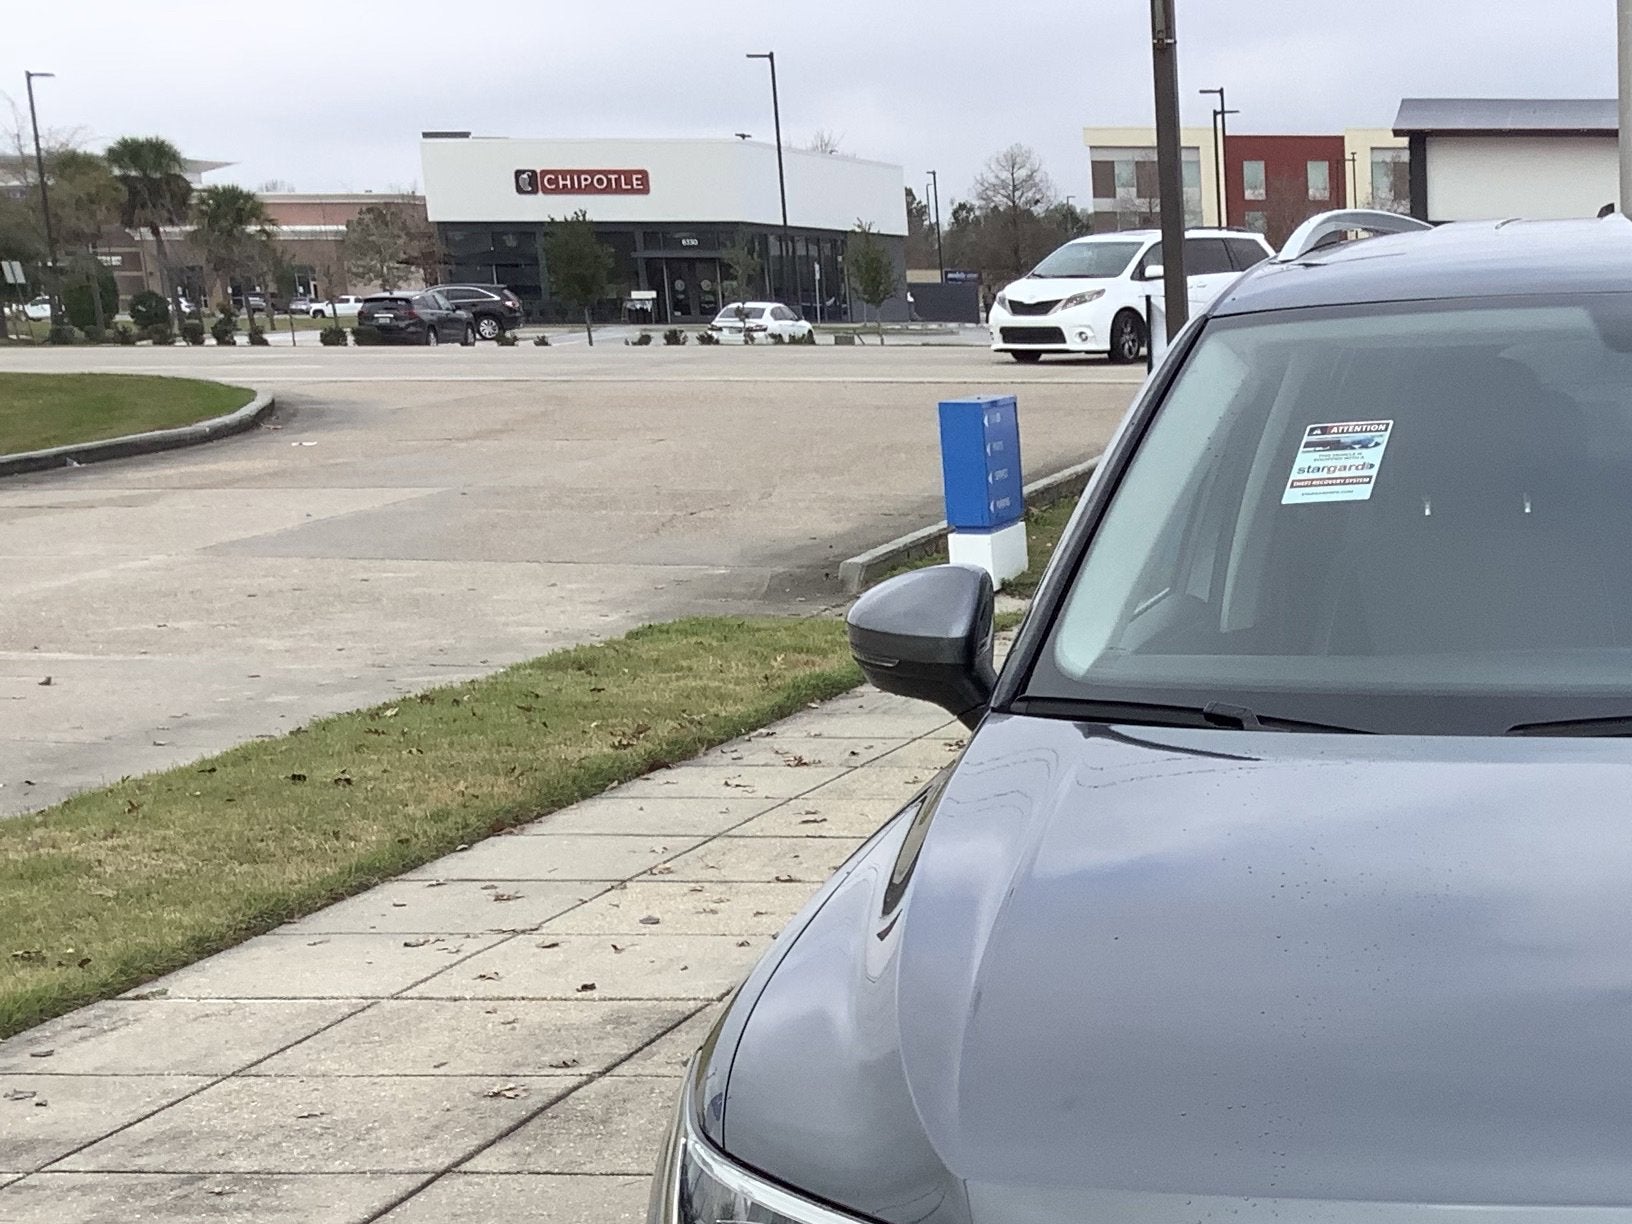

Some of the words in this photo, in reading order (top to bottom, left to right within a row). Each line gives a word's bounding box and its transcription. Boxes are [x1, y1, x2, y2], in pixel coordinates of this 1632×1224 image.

[543, 174, 644, 189] CHIPOTLE
[1331, 424, 1386, 433] ATTENTION
[1297, 462, 1366, 474] stargard
